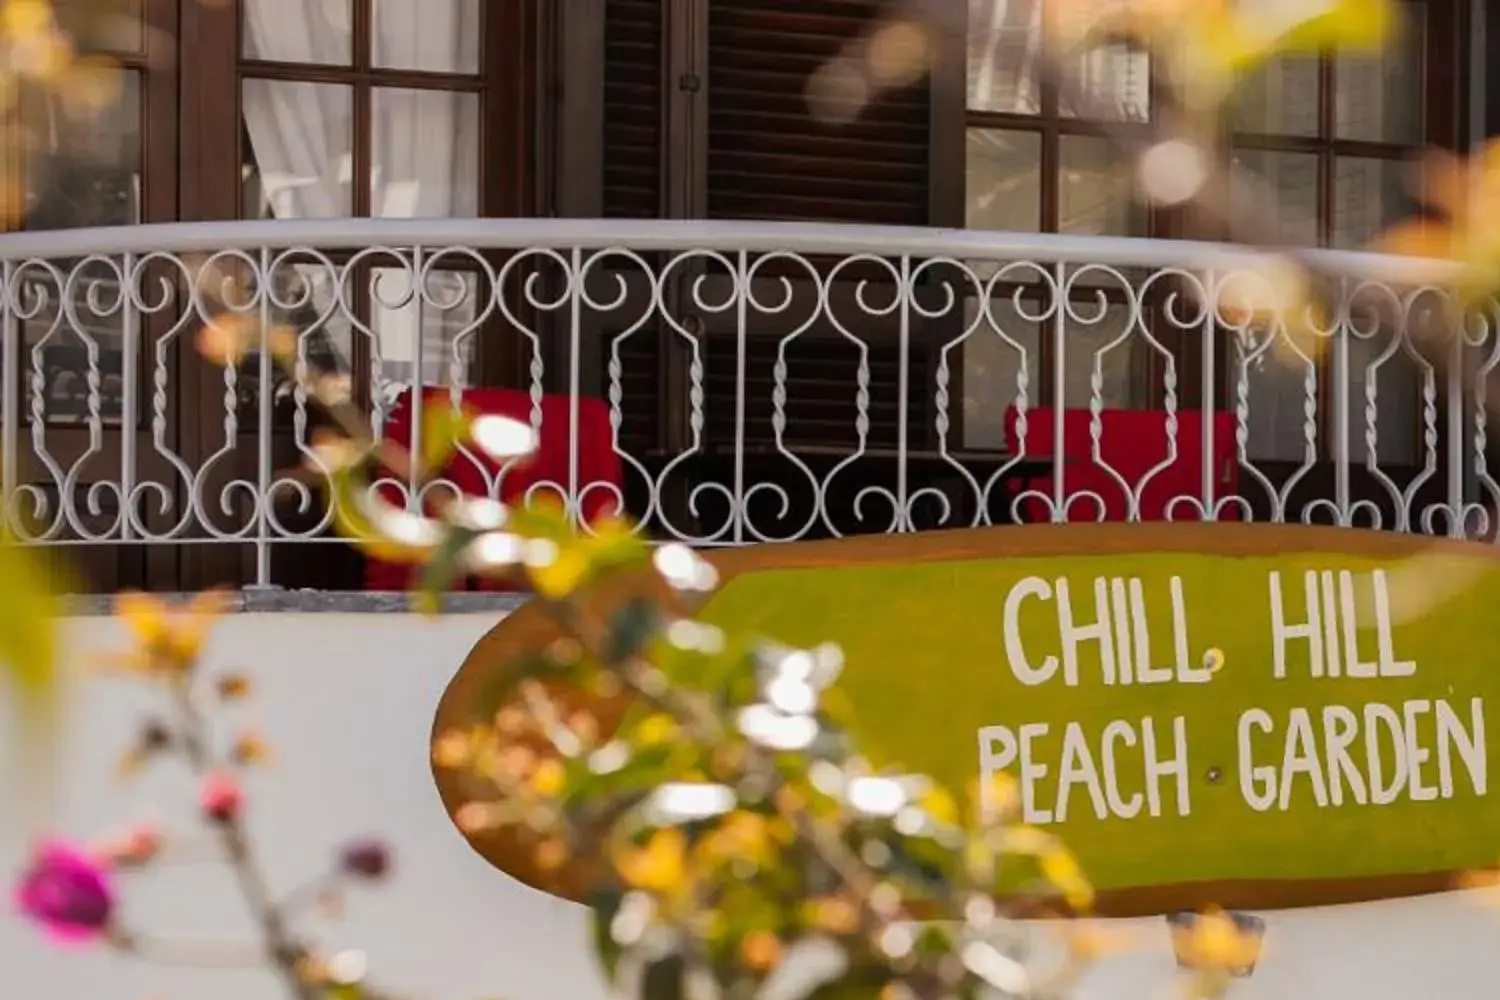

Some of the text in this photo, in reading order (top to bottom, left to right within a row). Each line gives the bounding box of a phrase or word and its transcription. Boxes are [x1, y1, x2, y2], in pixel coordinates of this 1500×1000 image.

[1002, 569, 1417, 687] CHILL HILL
[977, 697, 1487, 824] PEACH GARDEN
